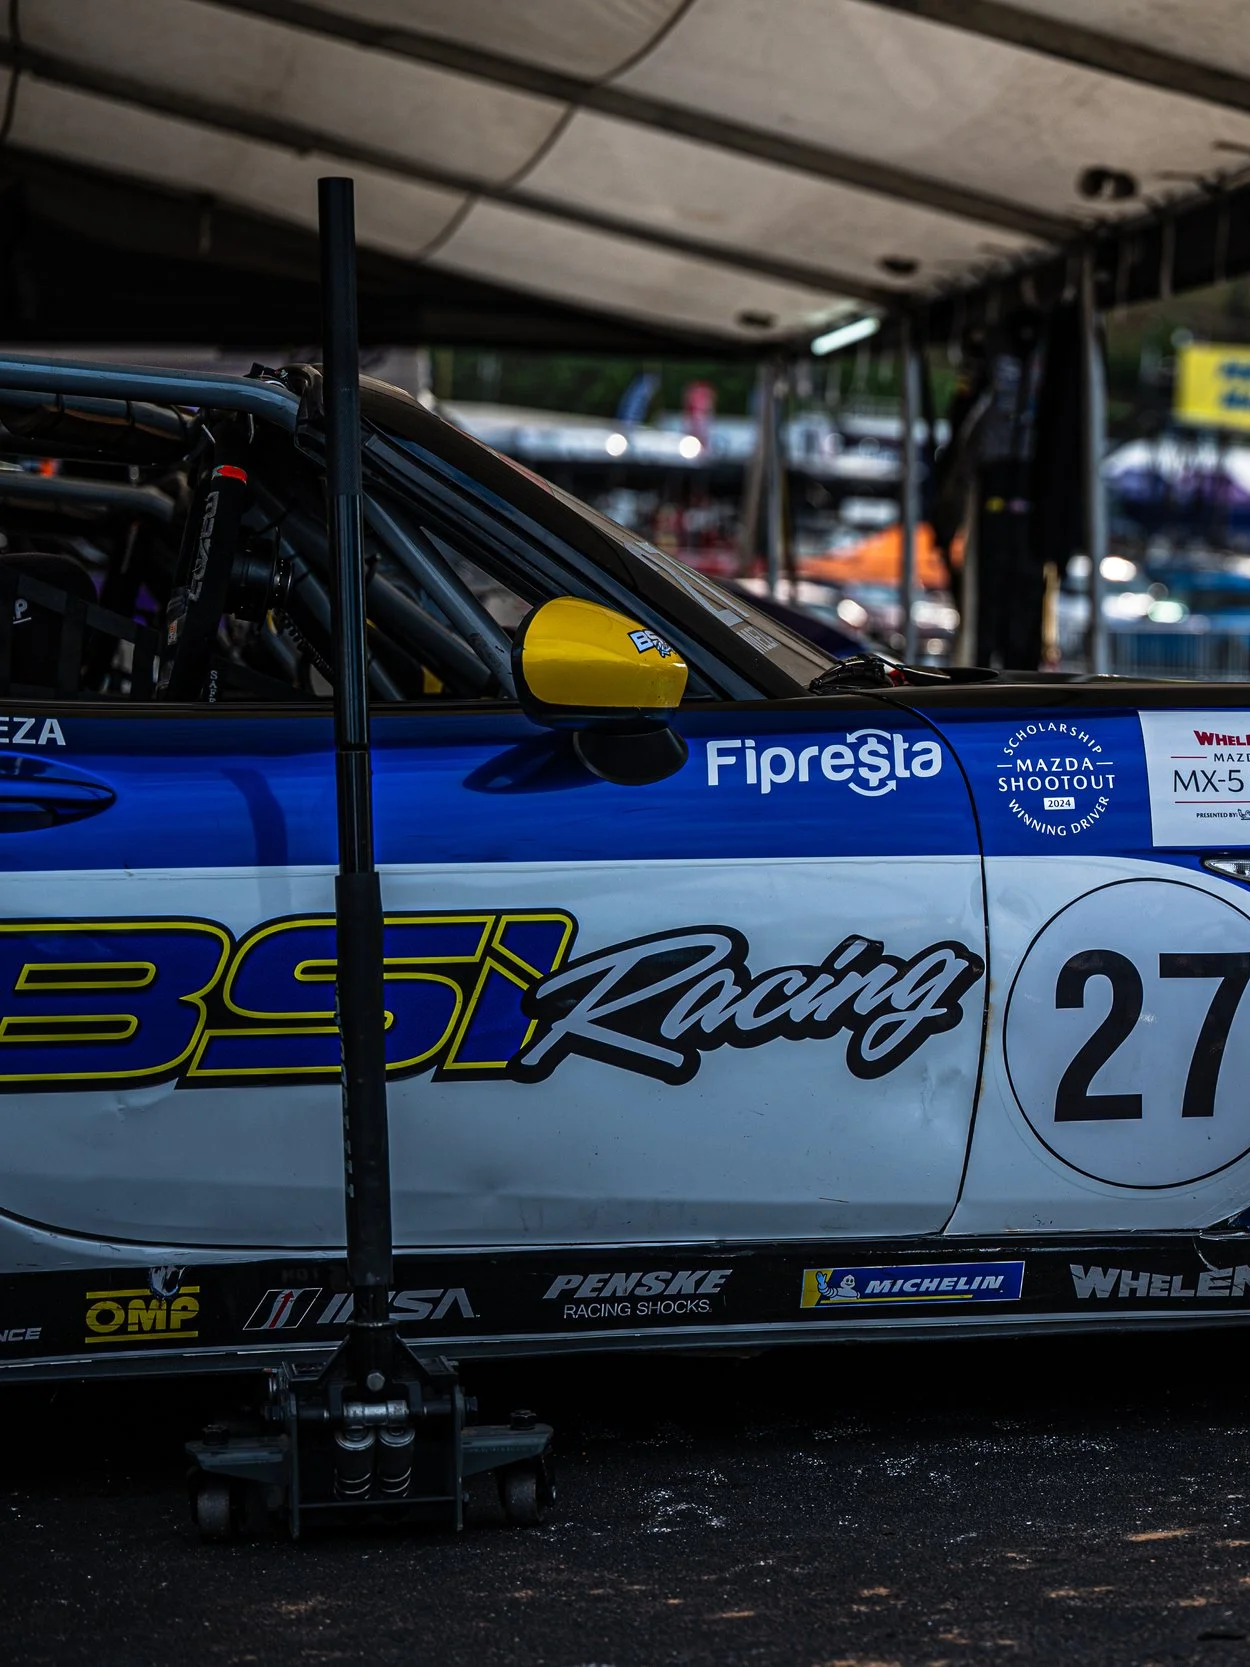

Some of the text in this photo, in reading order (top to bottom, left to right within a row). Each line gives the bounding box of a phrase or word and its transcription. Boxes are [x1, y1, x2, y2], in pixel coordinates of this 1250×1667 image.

[1003, 722, 1102, 756] SCHOLARSHIP
[1016, 757, 1094, 772] MAZDA
[998, 774, 1116, 792] SHOOTOUT
[1173, 769, 1245, 793] MX-5
[1008, 796, 1110, 836] WINNING DRIVER
[1047, 799, 1072, 808] 2024
[508, 927, 980, 1080] Racing
[542, 1269, 733, 1299] PENSKE
[863, 1275, 1005, 1293] MICHELIN
[85, 1296, 200, 1333] OMP
[316, 1287, 476, 1325] ISA
[563, 1299, 711, 1319] RACING SHOCKS
